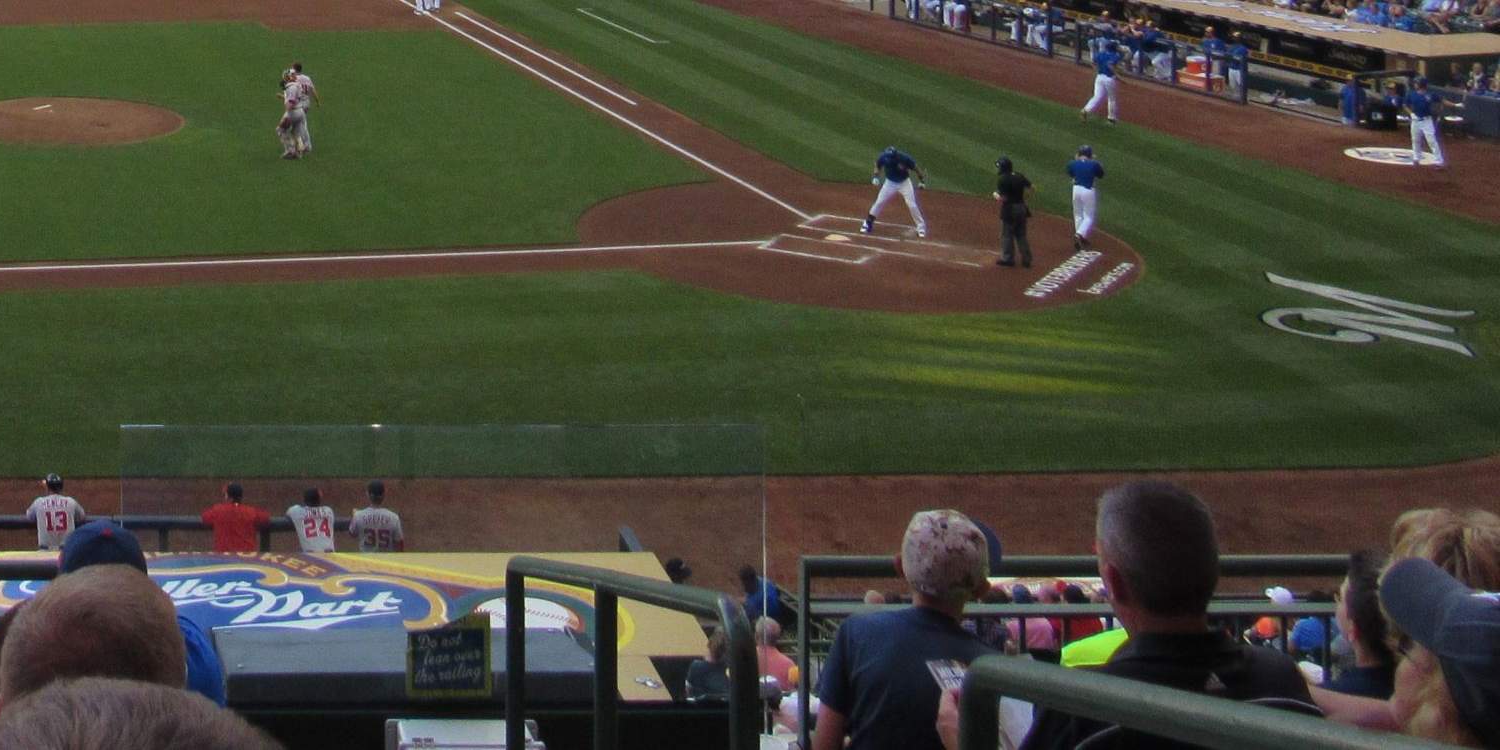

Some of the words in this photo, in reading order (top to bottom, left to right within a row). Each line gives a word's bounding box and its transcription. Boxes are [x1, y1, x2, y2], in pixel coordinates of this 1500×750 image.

[45, 511, 68, 531] 13
[302, 517, 332, 538] 24
[363, 528, 392, 547] 35
[224, 587, 402, 625] Park
[418, 634, 438, 649] Do
[441, 631, 462, 647] not
[423, 650, 450, 665] lean
[414, 667, 437, 684] the
